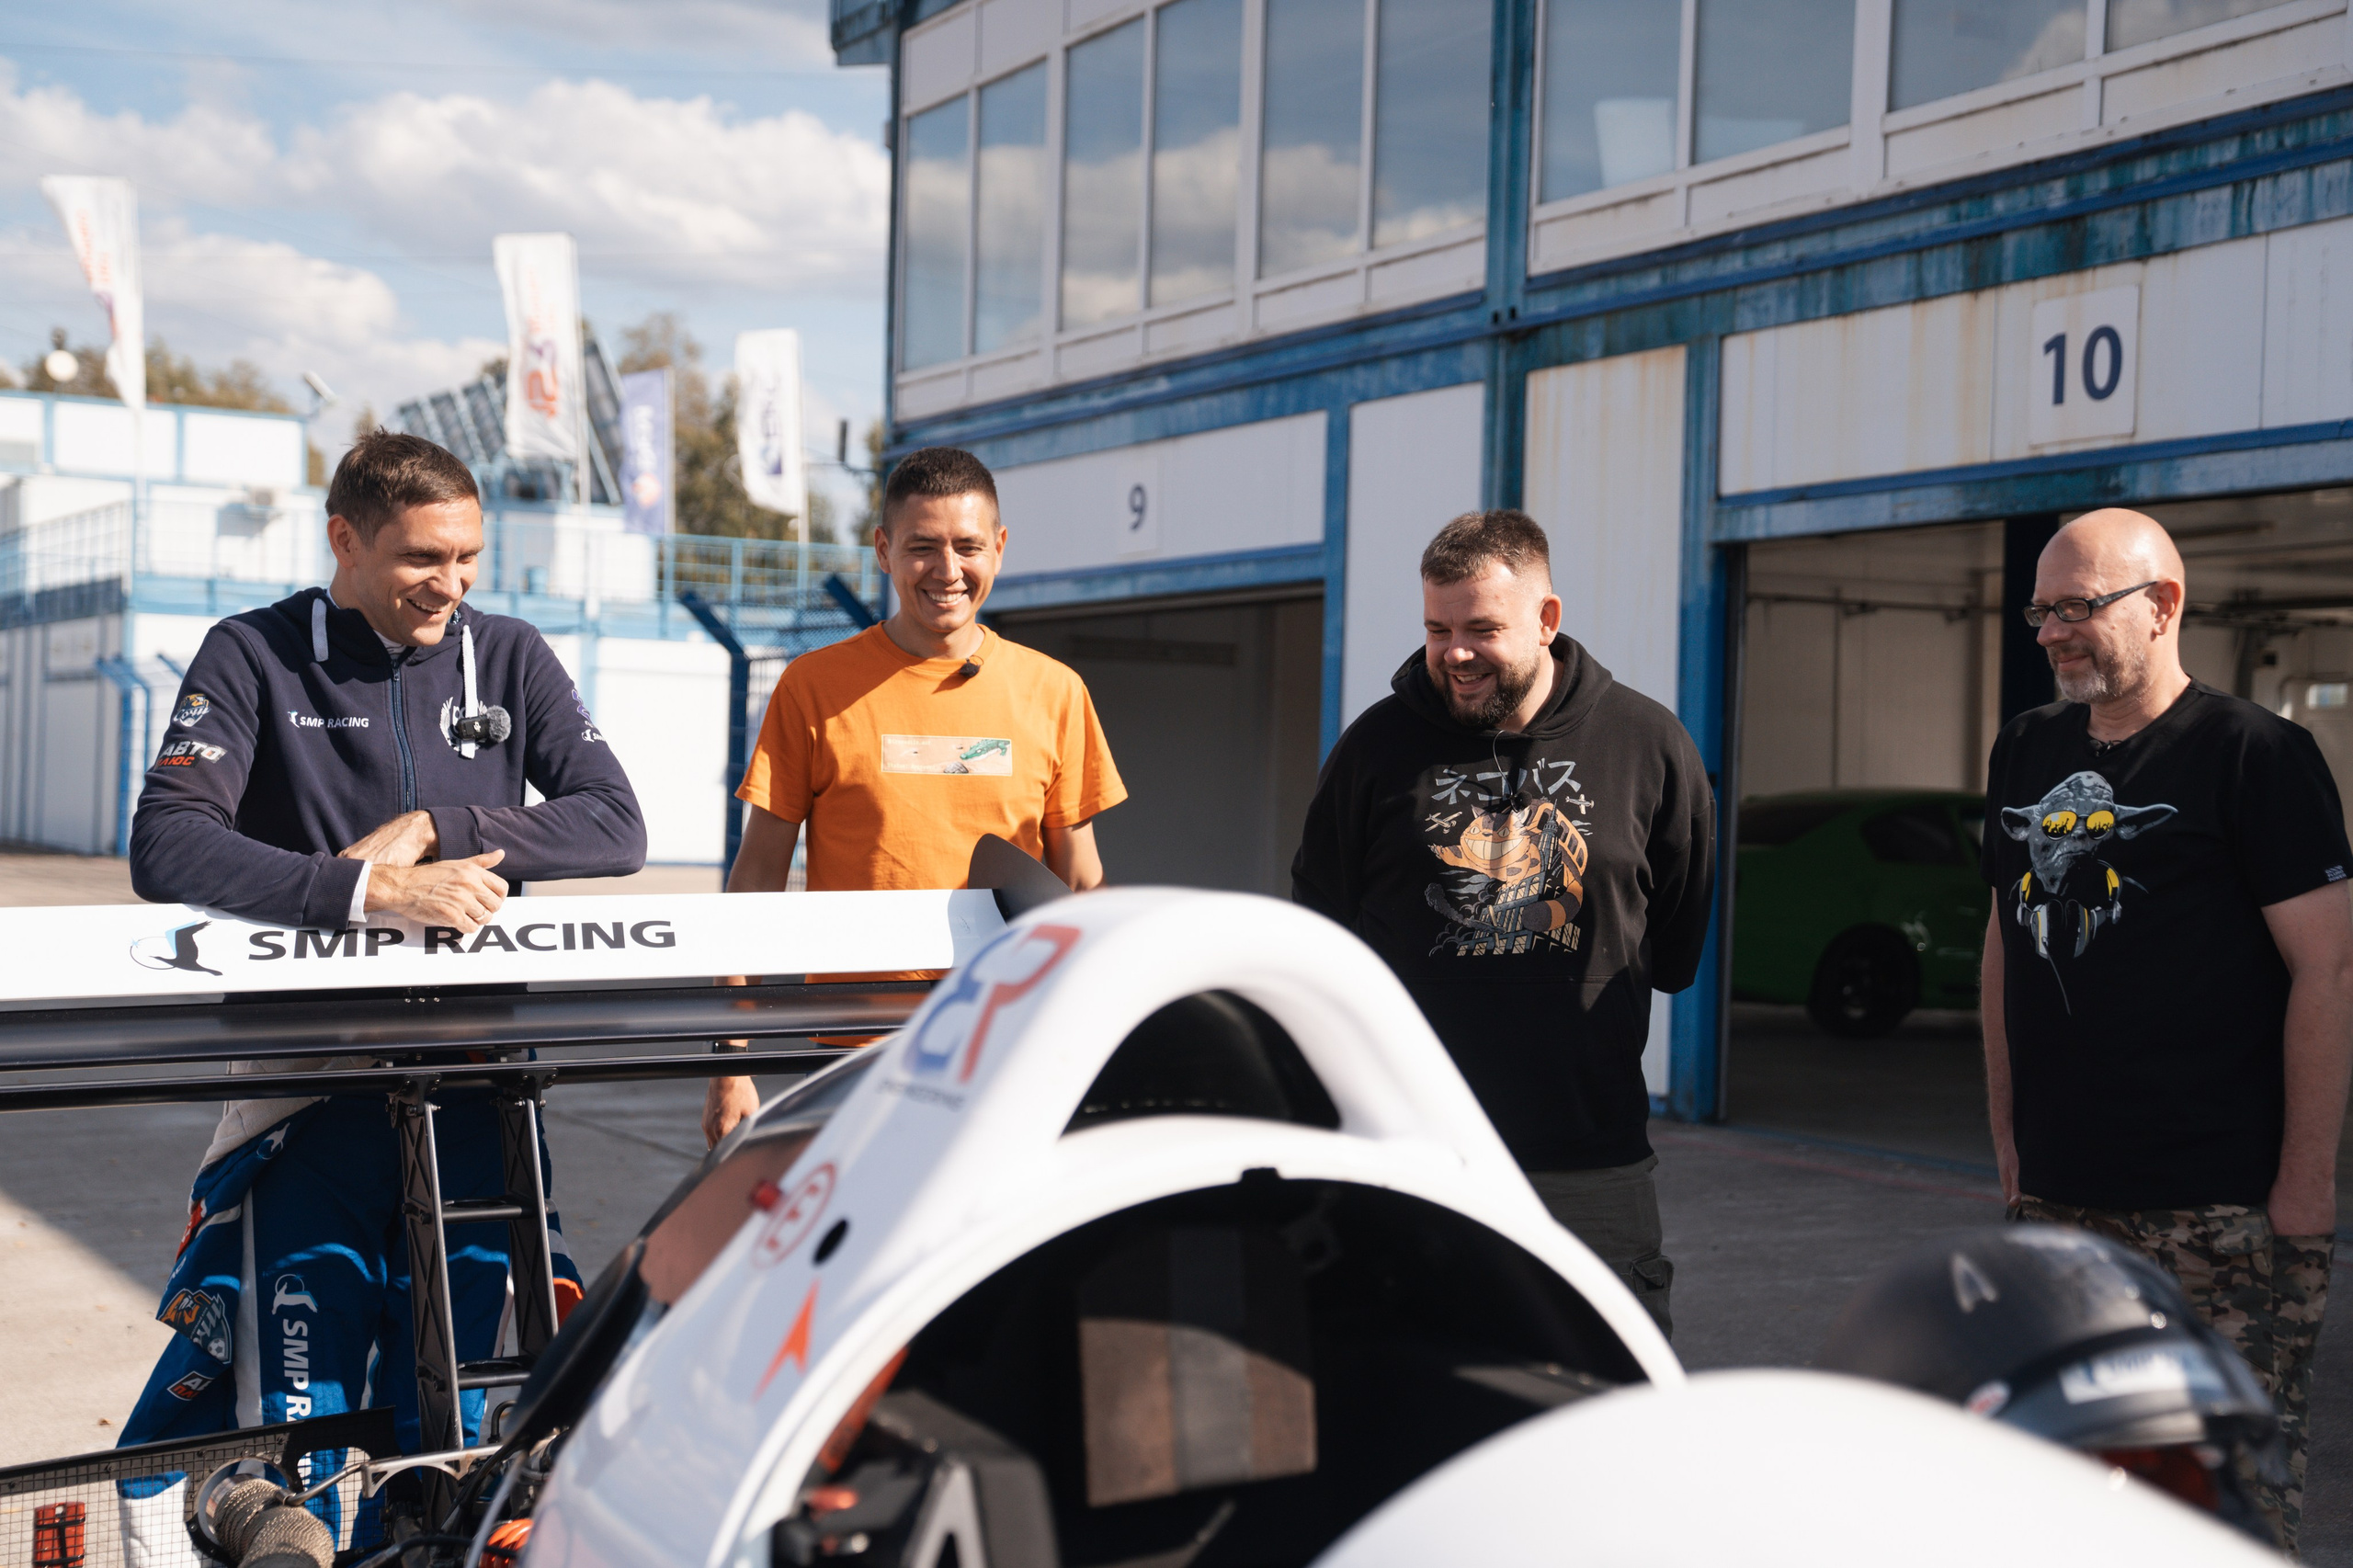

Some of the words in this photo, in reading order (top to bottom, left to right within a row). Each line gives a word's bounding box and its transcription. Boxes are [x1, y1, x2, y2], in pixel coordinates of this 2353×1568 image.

[2043, 324, 2122, 405] 10
[1129, 483, 1147, 531] 9
[173, 706, 211, 722] Сочи
[300, 716, 324, 728] SMP
[327, 717, 369, 728] RACING
[160, 741, 222, 760] АВТО
[1431, 757, 1582, 805] ネコバス
[248, 928, 404, 960] SMP
[424, 920, 676, 955] RACING
[282, 1318, 310, 1391] SMP
